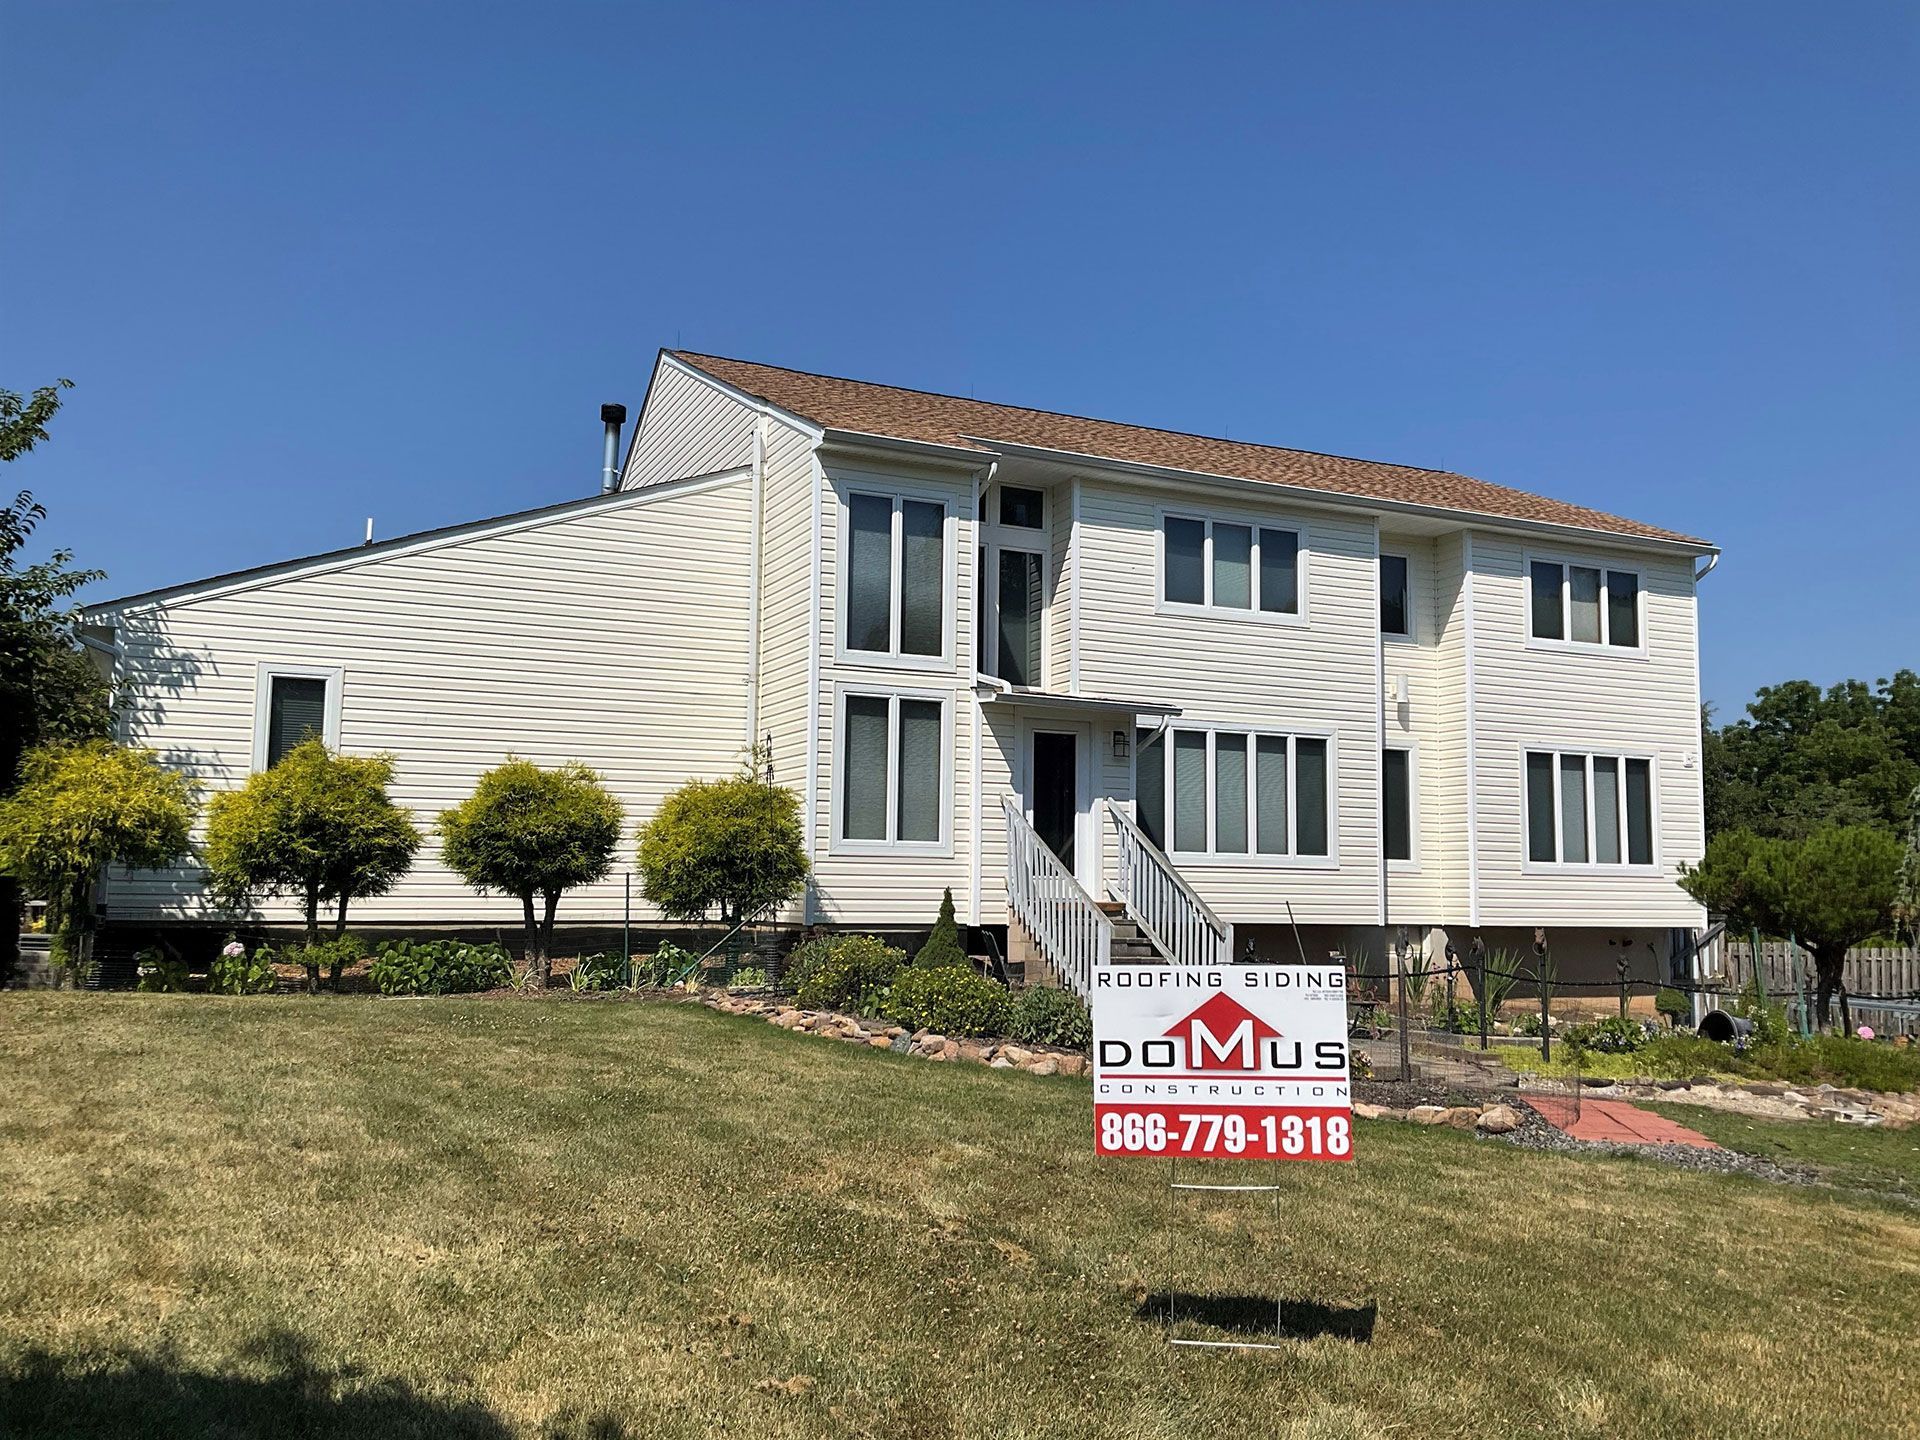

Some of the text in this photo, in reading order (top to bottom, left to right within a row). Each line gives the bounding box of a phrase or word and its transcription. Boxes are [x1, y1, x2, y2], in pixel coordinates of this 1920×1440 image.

[1098, 972, 1344, 988] ROOFING SIDING
[1099, 1019, 1346, 1069] DOMUS
[1100, 1084, 1348, 1096] CONSTRUCTION
[1101, 1112, 1350, 1155] 866-779-1318
